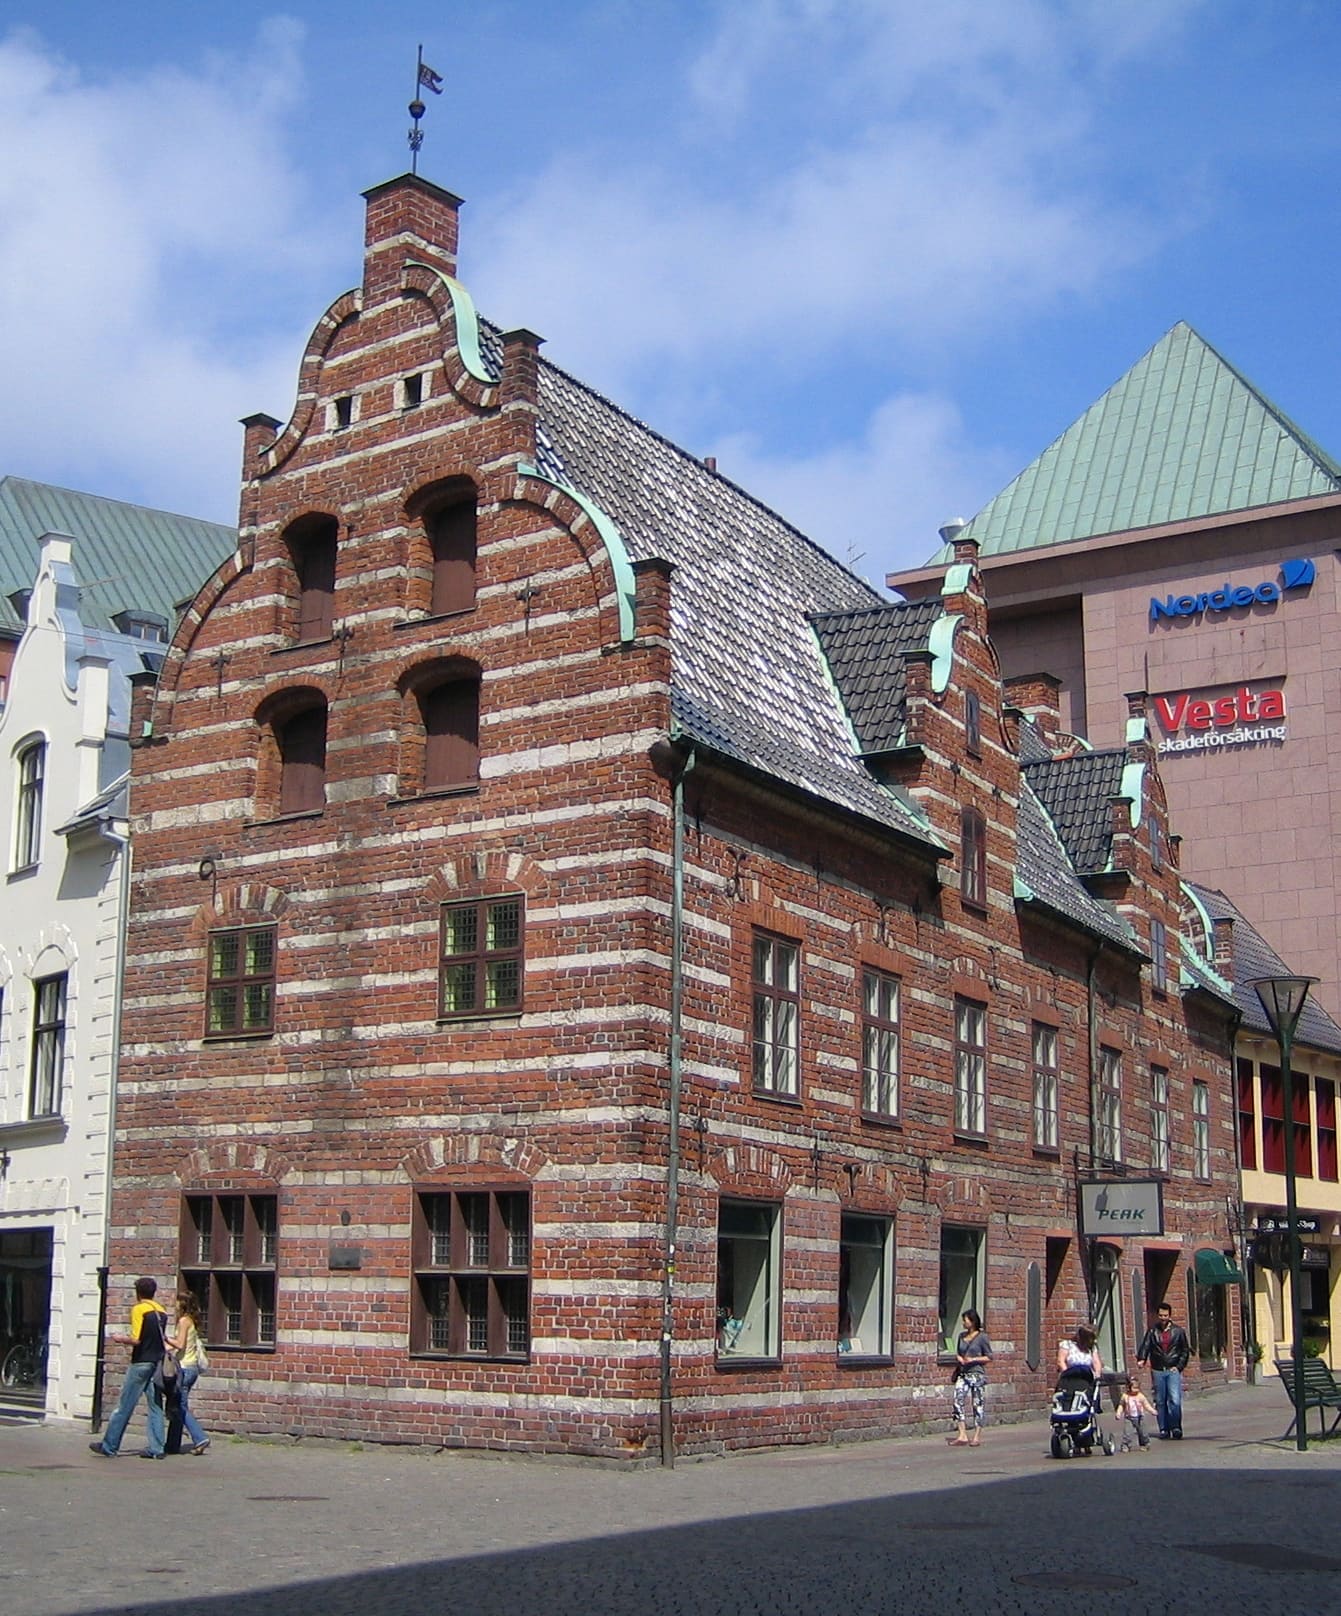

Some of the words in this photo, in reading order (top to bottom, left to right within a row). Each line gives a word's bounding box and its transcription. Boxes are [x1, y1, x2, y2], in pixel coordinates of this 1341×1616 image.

[1150, 582, 1280, 620] Nordea
[1154, 687, 1286, 732] Vesta
[1158, 726, 1287, 753] skadeförsäkring
[1098, 1208, 1145, 1220] PEAK
